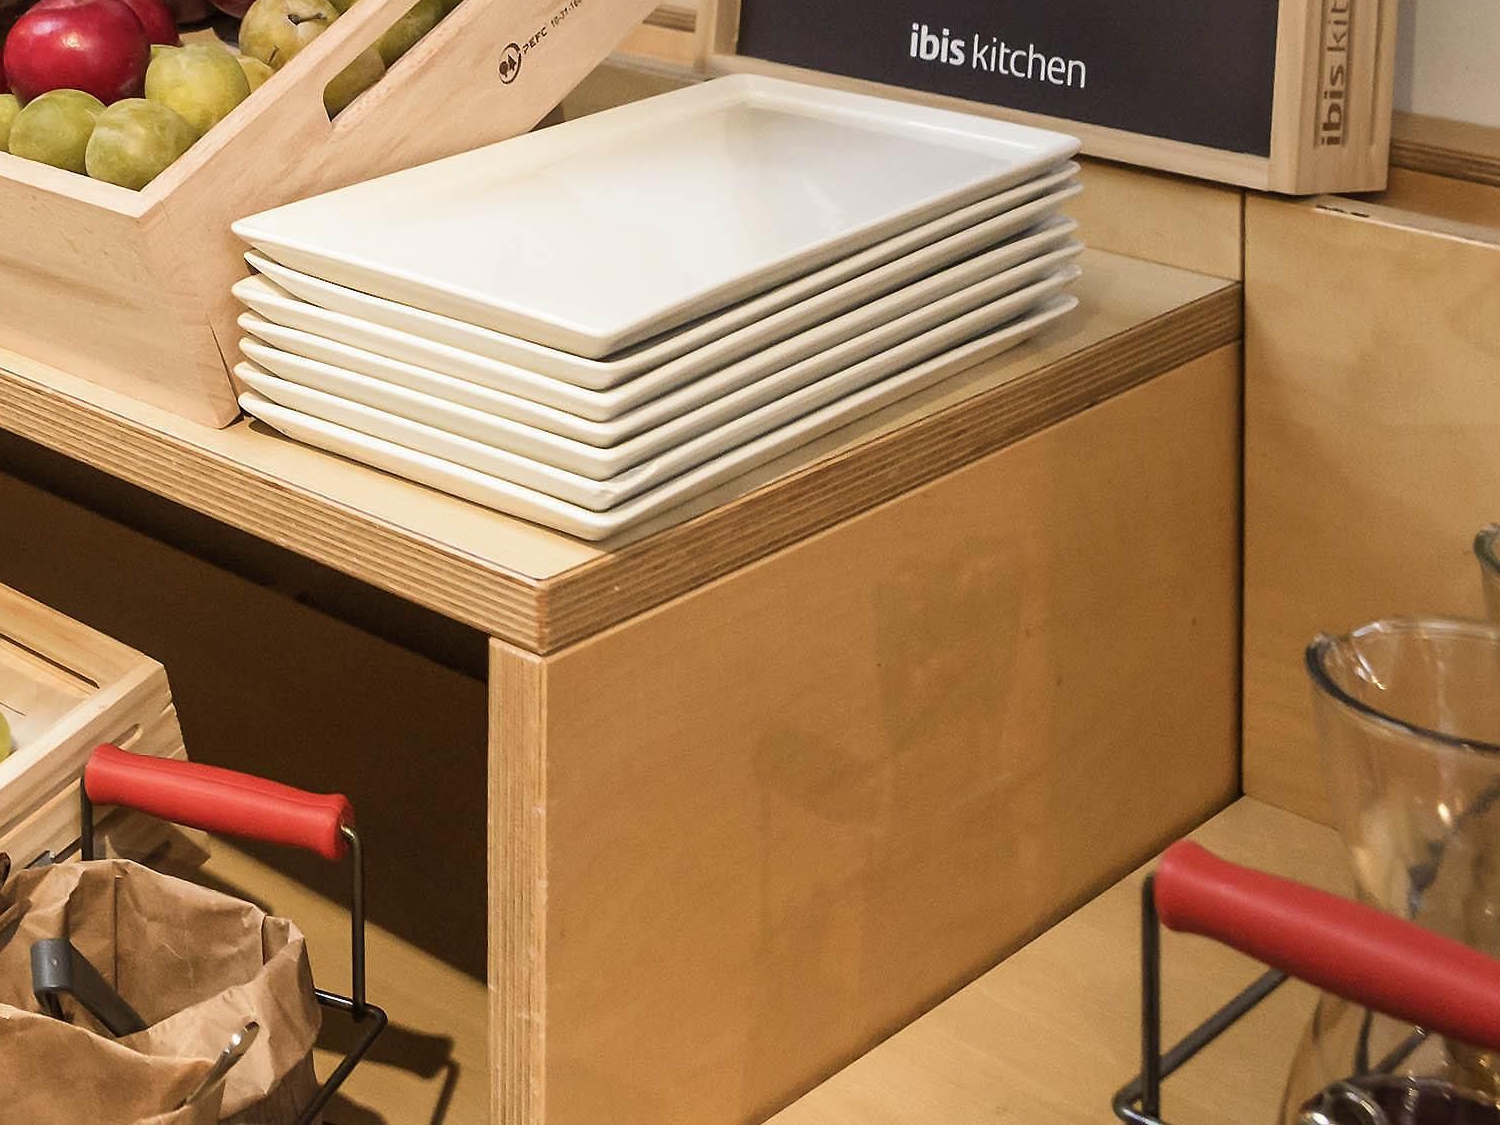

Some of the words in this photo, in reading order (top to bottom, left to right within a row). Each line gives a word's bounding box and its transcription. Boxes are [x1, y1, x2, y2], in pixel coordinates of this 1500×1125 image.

[522, 26, 548, 55] PEFC
[909, 22, 965, 66] ibis
[971, 33, 1086, 89] kitchen
[1321, 62, 1345, 147] ibis
